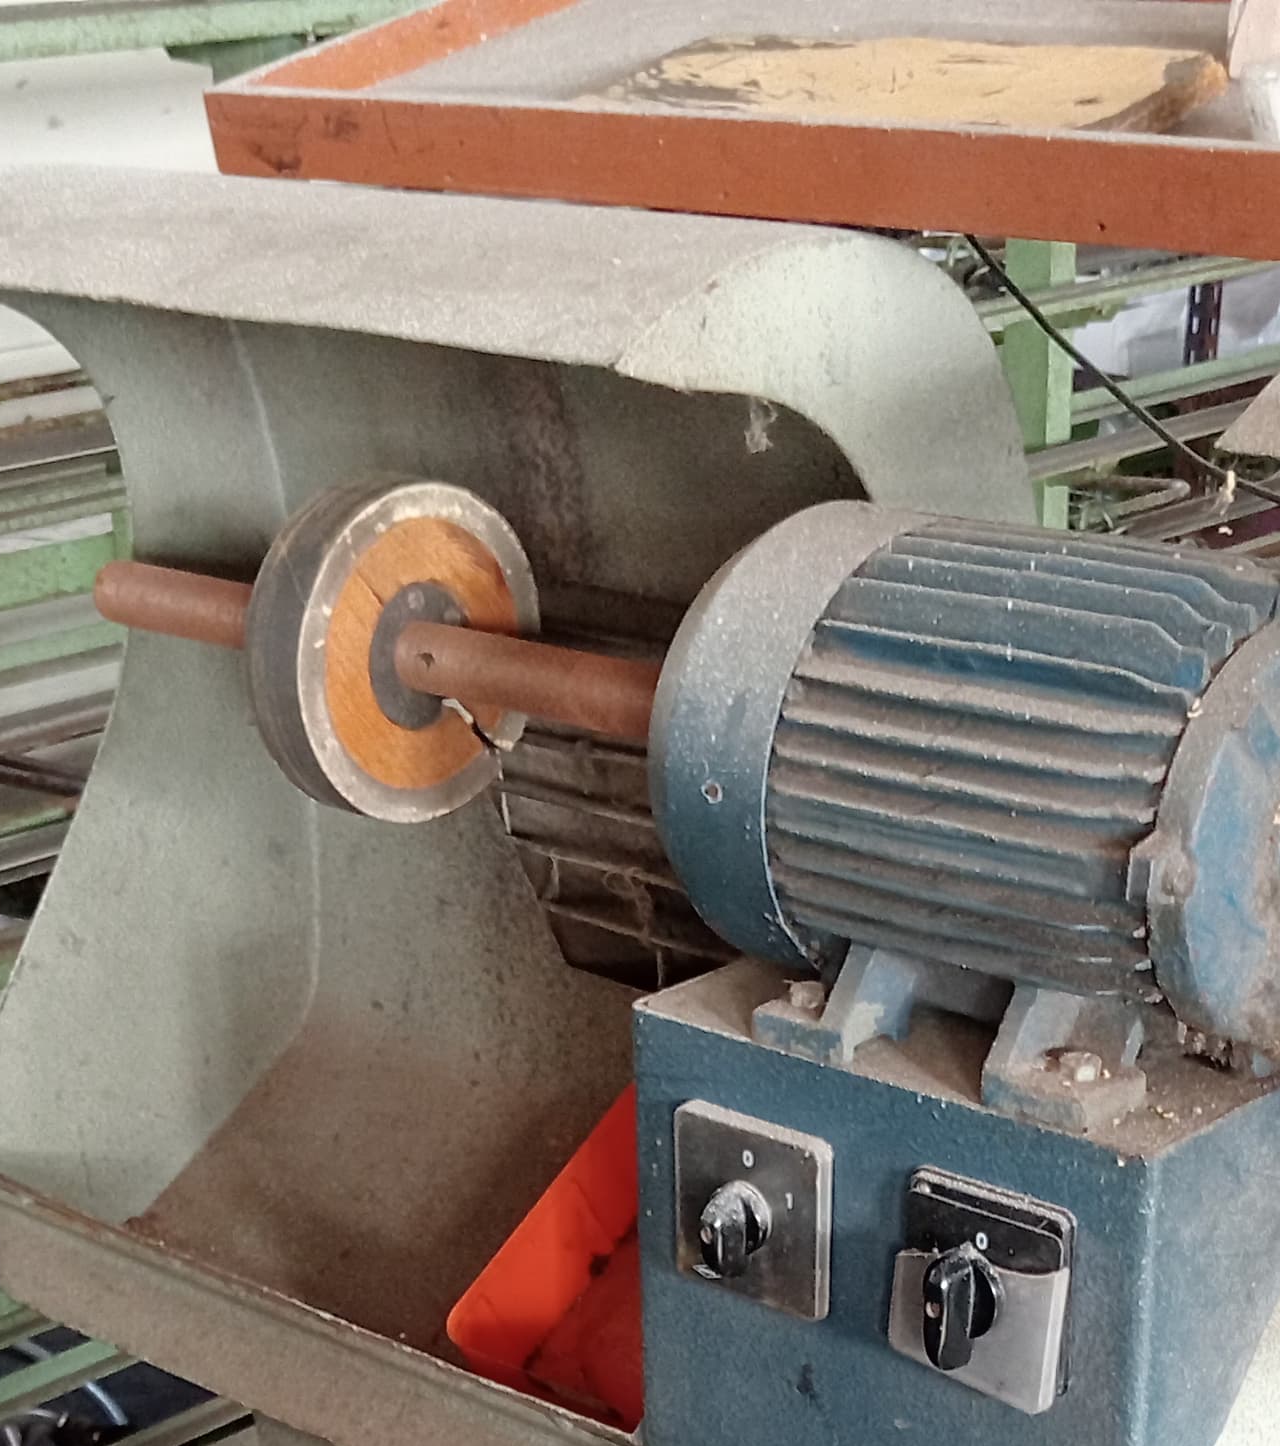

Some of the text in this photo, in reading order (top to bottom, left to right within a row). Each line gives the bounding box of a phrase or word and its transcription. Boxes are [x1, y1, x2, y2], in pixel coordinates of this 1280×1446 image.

[742, 1149, 755, 1168] 0
[784, 1191, 794, 1210] 1
[975, 1232, 988, 1251] 0
